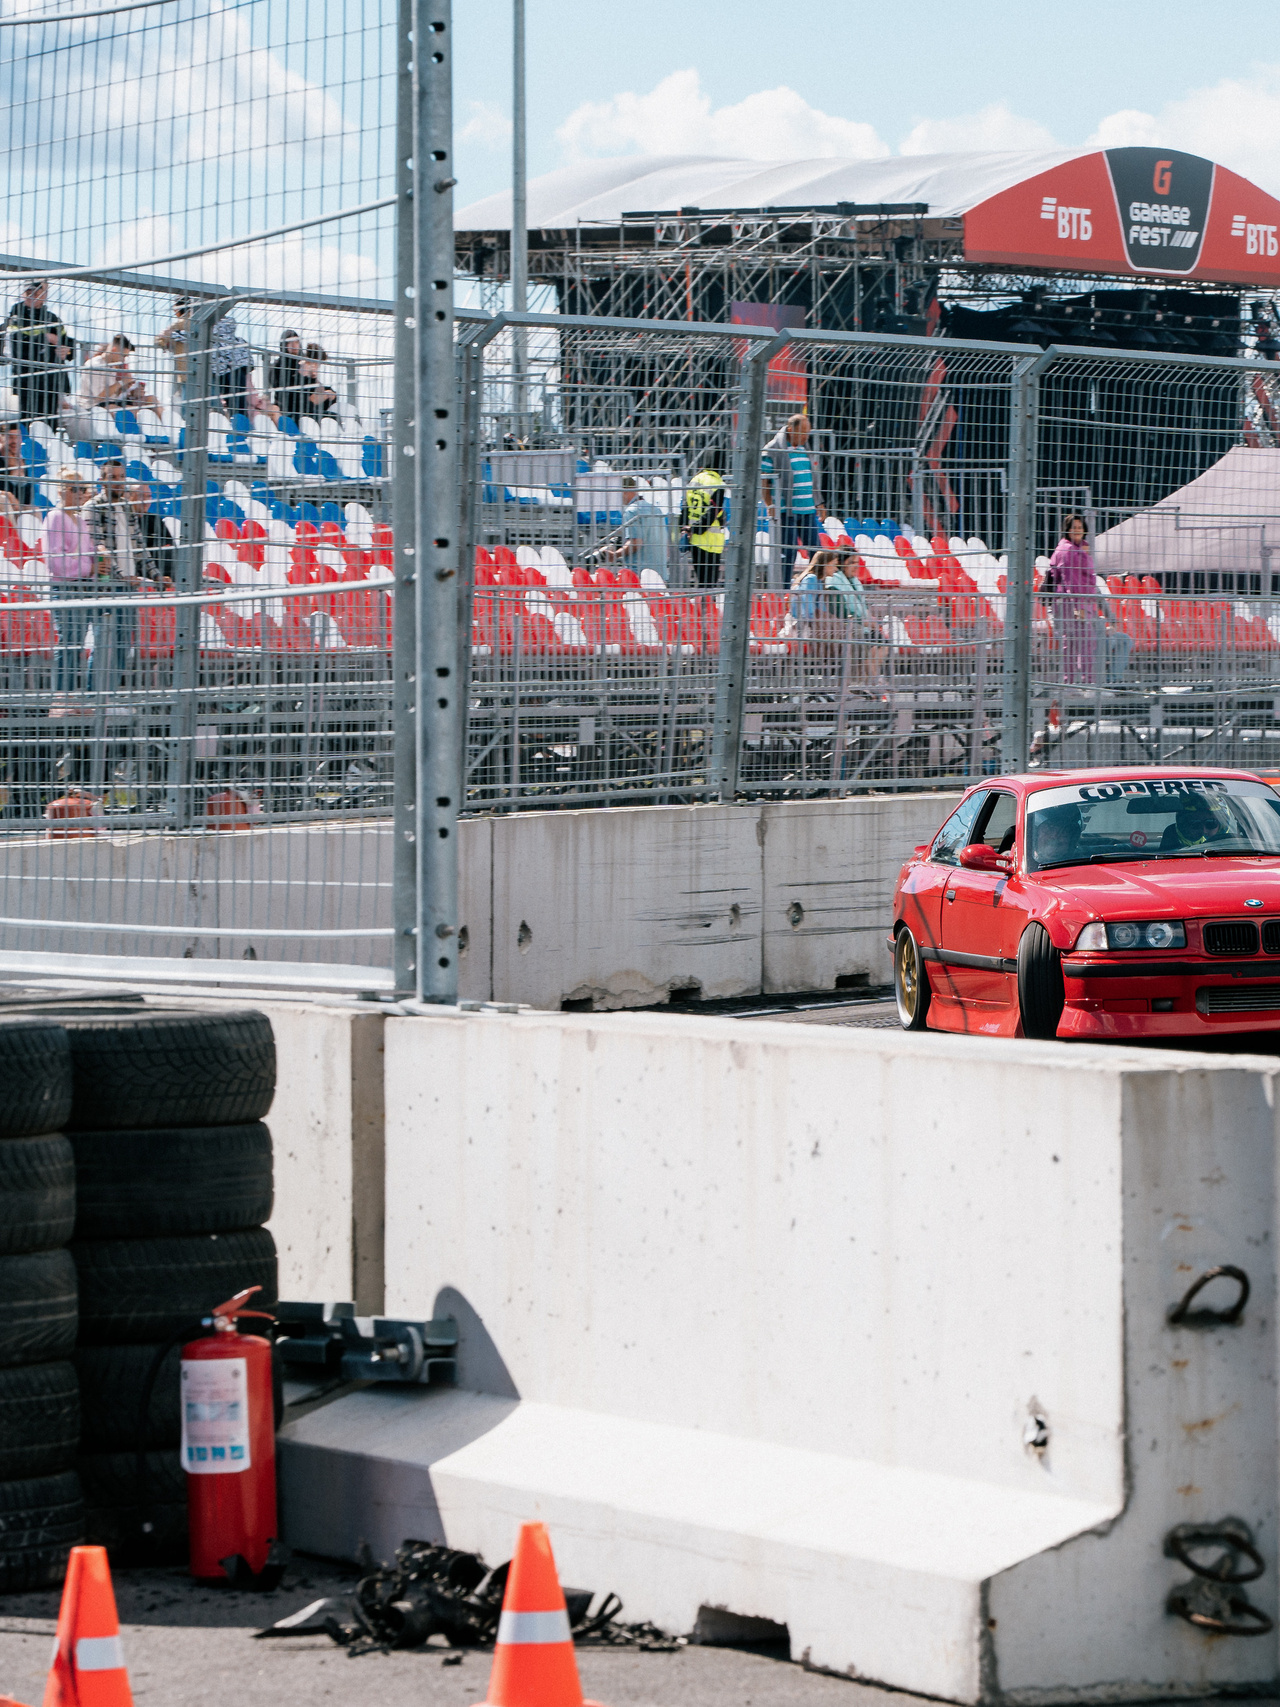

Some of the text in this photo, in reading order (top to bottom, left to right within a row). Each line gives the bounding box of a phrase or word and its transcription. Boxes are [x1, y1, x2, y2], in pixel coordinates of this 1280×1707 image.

[1153, 160, 1173, 195] G
[1057, 206, 1092, 241] ВТБ
[1246, 223, 1279, 257] ВТБ
[1078, 780, 1228, 801] CODERED
